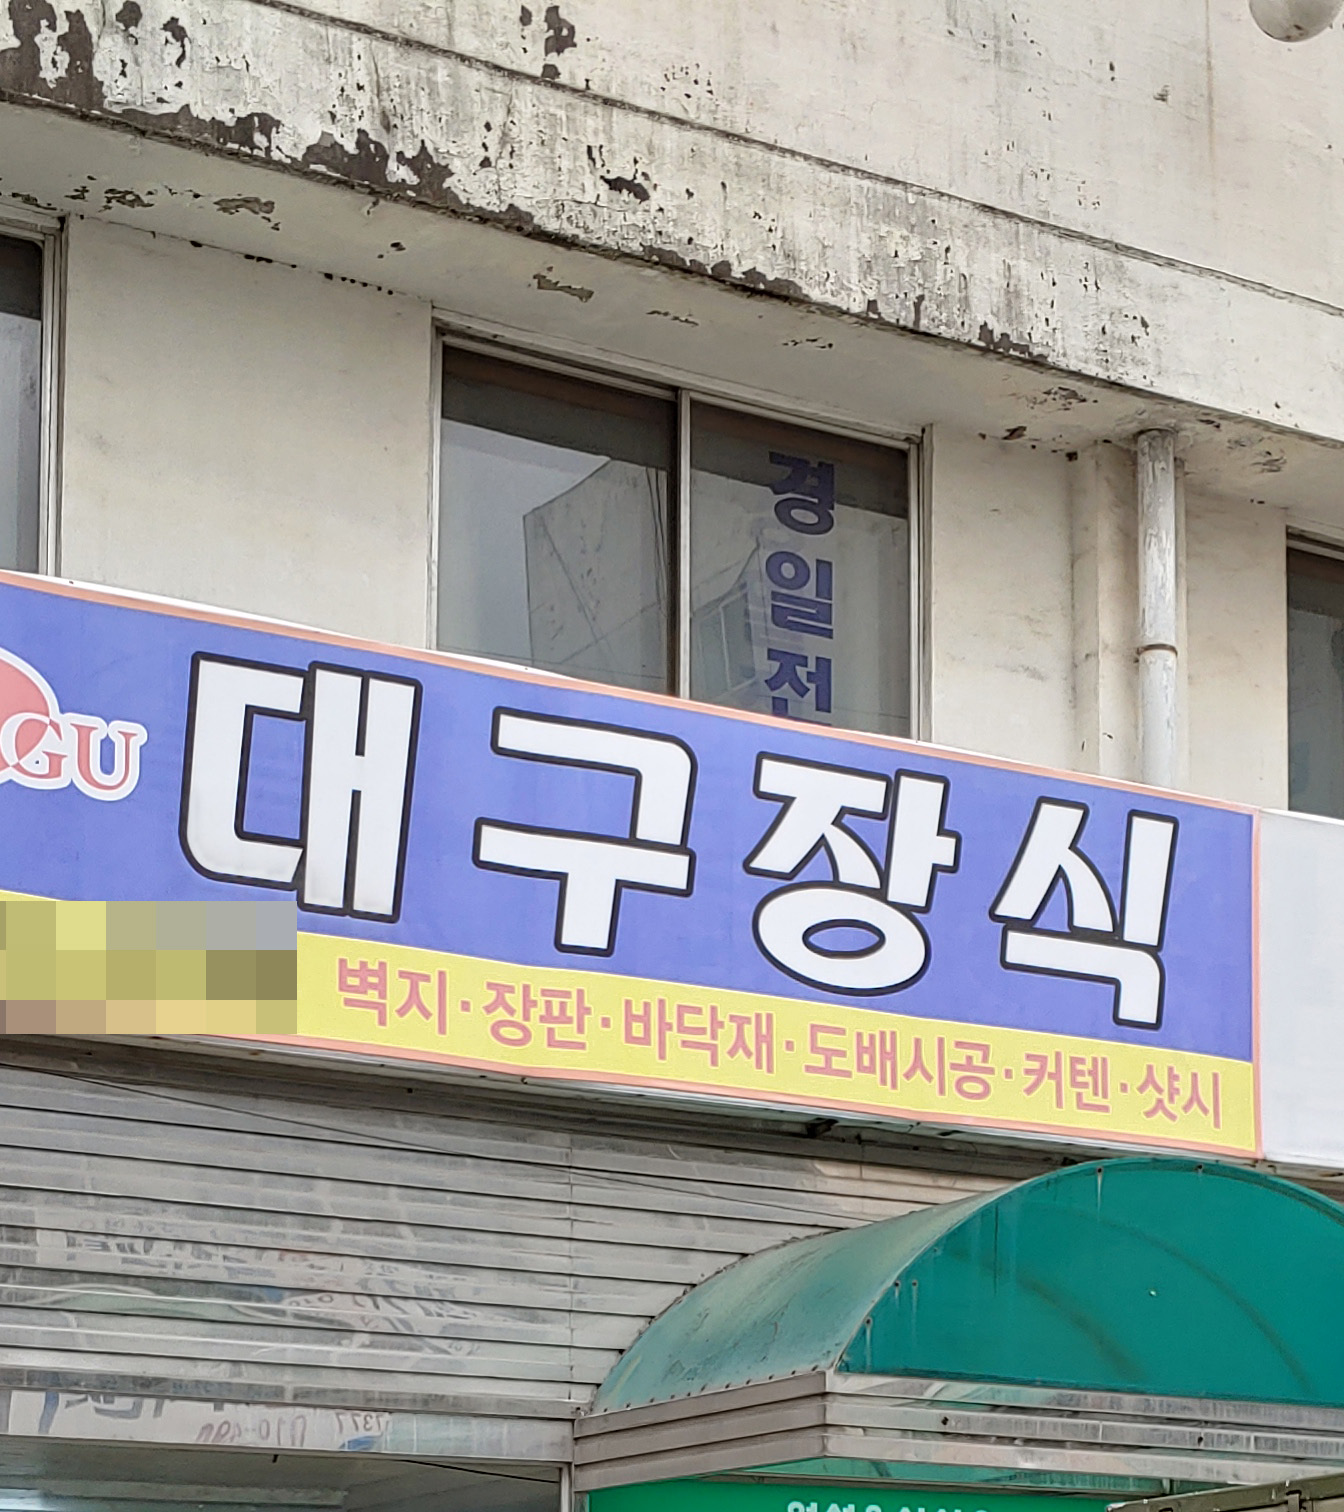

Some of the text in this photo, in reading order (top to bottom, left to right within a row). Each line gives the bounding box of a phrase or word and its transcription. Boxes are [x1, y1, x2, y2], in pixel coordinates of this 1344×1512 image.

[179, 652, 1178, 1028] 대구장식
[338, 957, 1222, 1130] 벽지 장판 바닥재 도배시공 커텐 샷시
